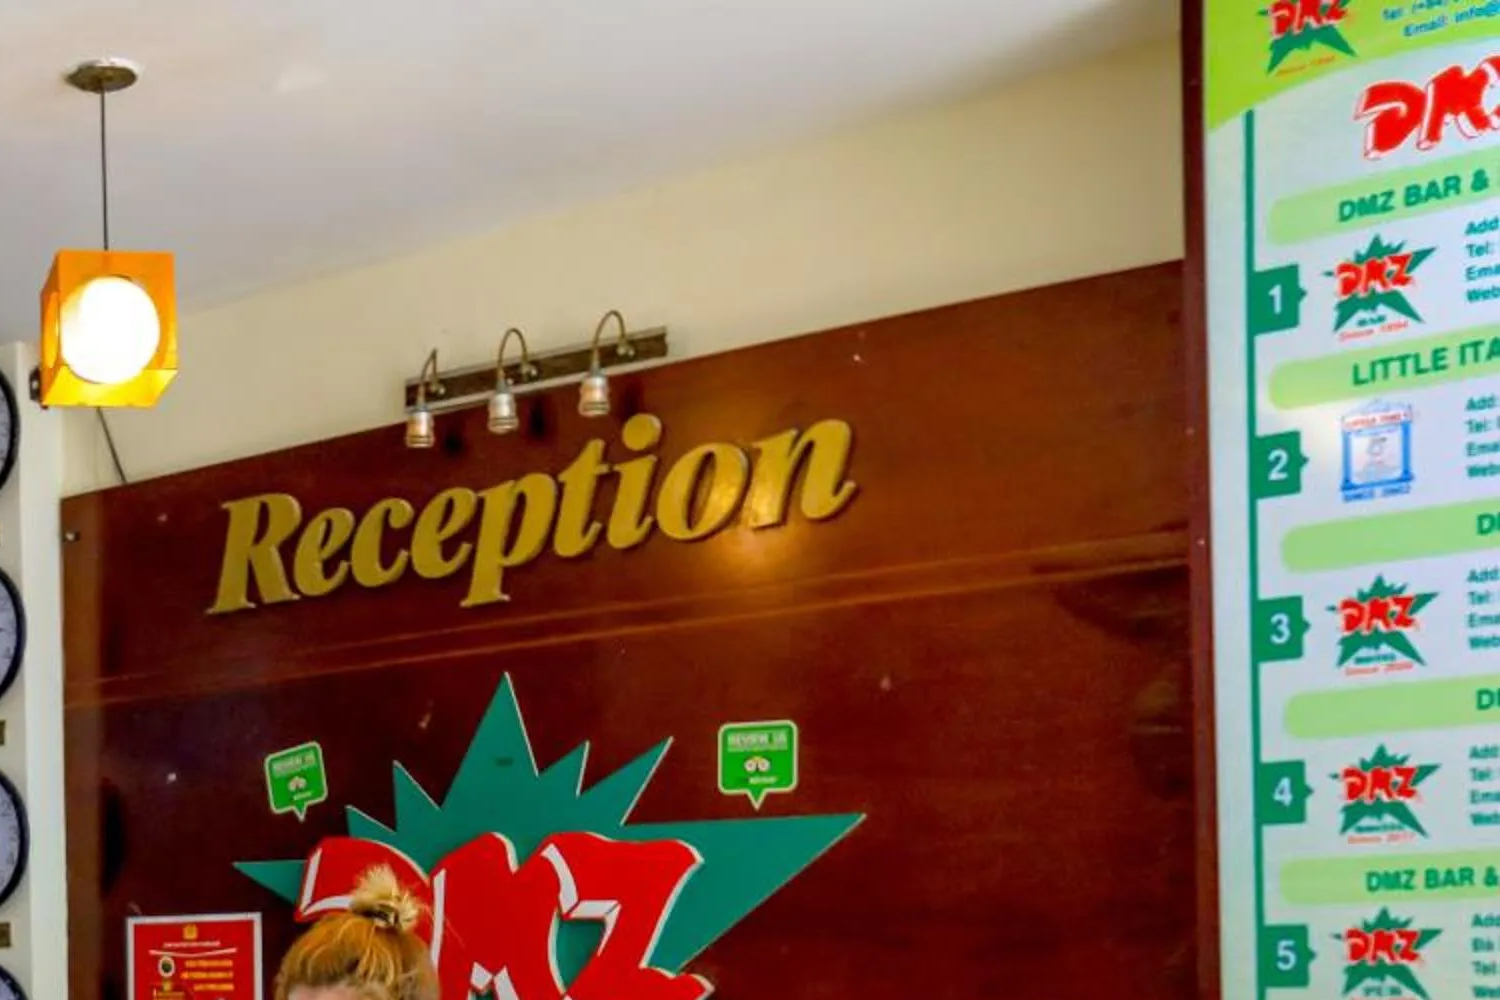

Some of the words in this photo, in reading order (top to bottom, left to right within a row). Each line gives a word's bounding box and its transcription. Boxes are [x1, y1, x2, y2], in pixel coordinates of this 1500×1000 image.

[1338, 190, 1396, 222] DMZ
[1403, 174, 1462, 207] BAR
[1470, 168, 1490, 192] &
[1335, 250, 1414, 299] DMZ
[1268, 283, 1283, 315] 1
[1351, 346, 1449, 387] LITTLE
[1458, 336, 1500, 368] ITA
[1267, 448, 1289, 481] 2
[206, 413, 858, 616] Reception
[1476, 513, 1500, 536] D
[1270, 612, 1291, 644] 3
[1338, 593, 1417, 637] DMZ
[1476, 688, 1500, 711] D
[1271, 776, 1293, 807] 4
[1340, 764, 1419, 805] DMZ
[1366, 870, 1417, 892] DMZ
[1423, 866, 1475, 890] BAR
[1483, 865, 1498, 887] &
[1275, 938, 1297, 971] 5
[1345, 926, 1421, 966] DMZ
